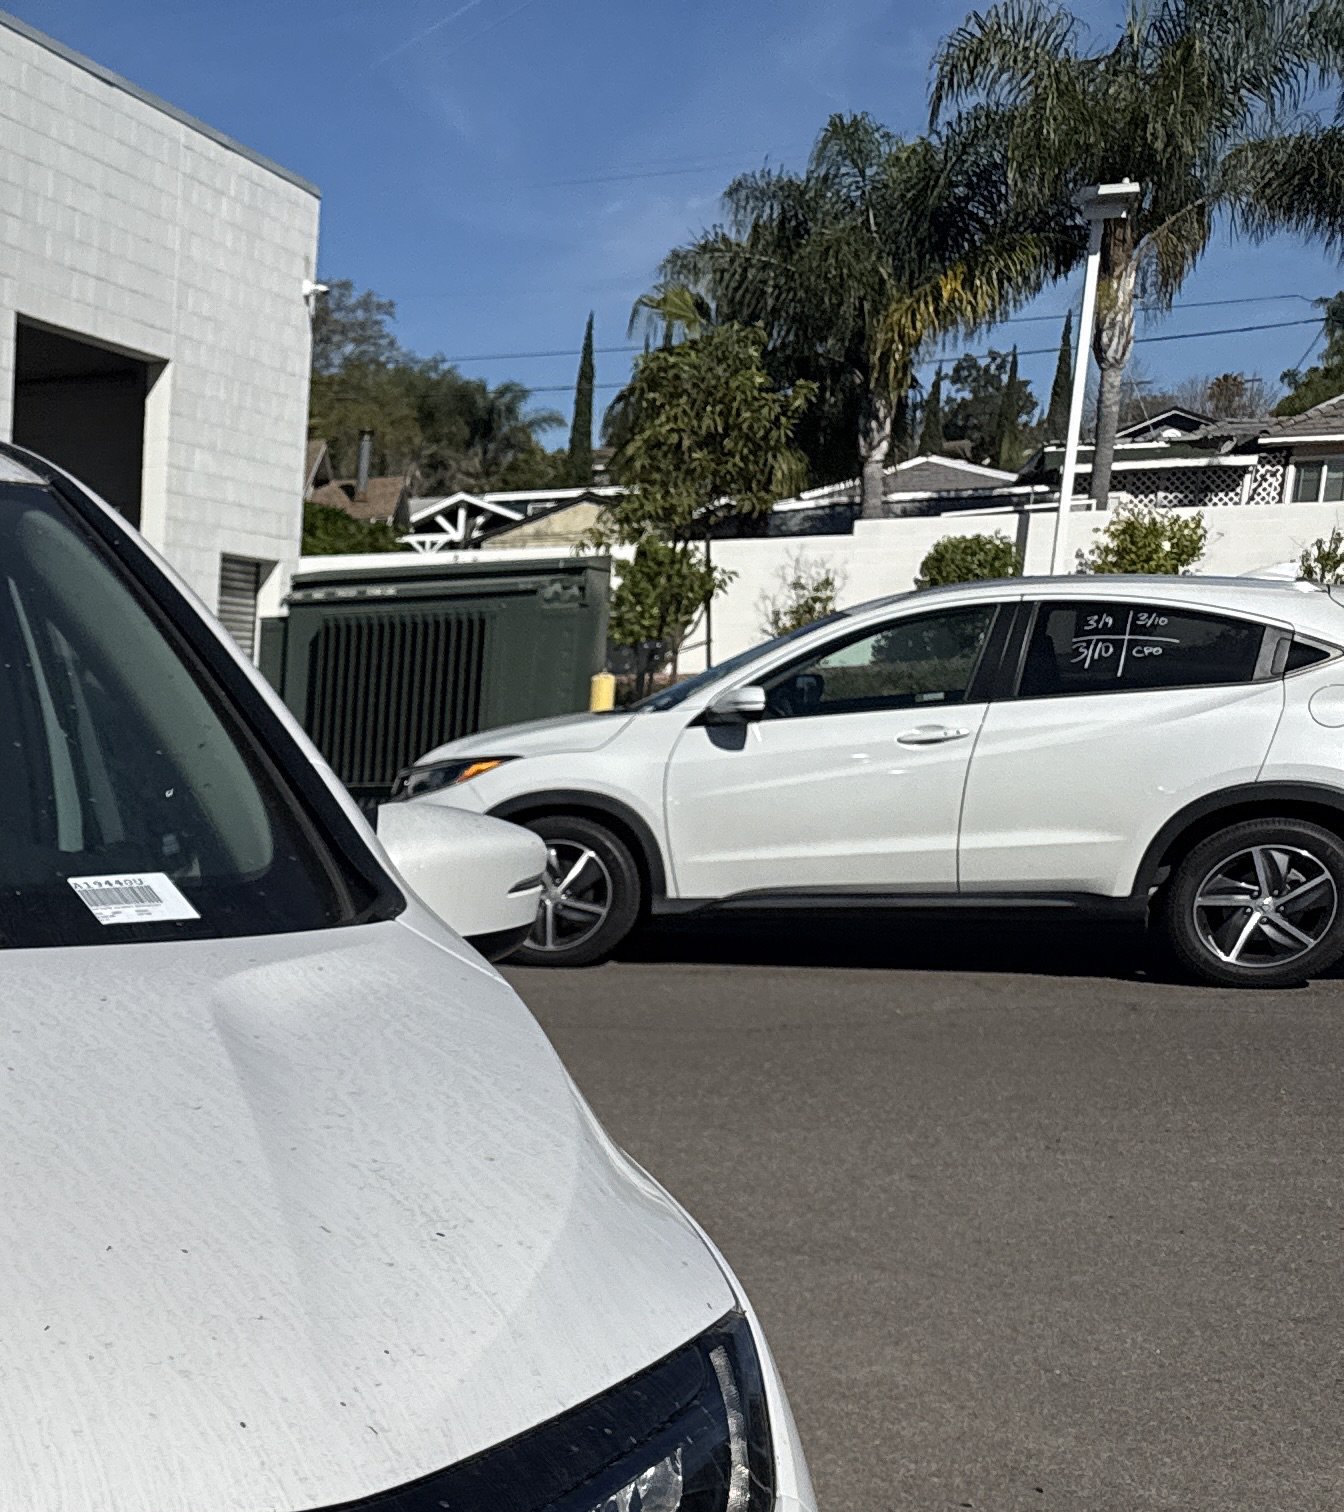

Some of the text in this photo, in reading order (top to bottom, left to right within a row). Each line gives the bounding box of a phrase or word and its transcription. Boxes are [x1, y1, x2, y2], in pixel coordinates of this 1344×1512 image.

[1083, 612, 1113, 630] 3/9
[1135, 612, 1169, 628] 3/10
[1070, 638, 1114, 670] 3/10
[1132, 645, 1163, 658] CPO
